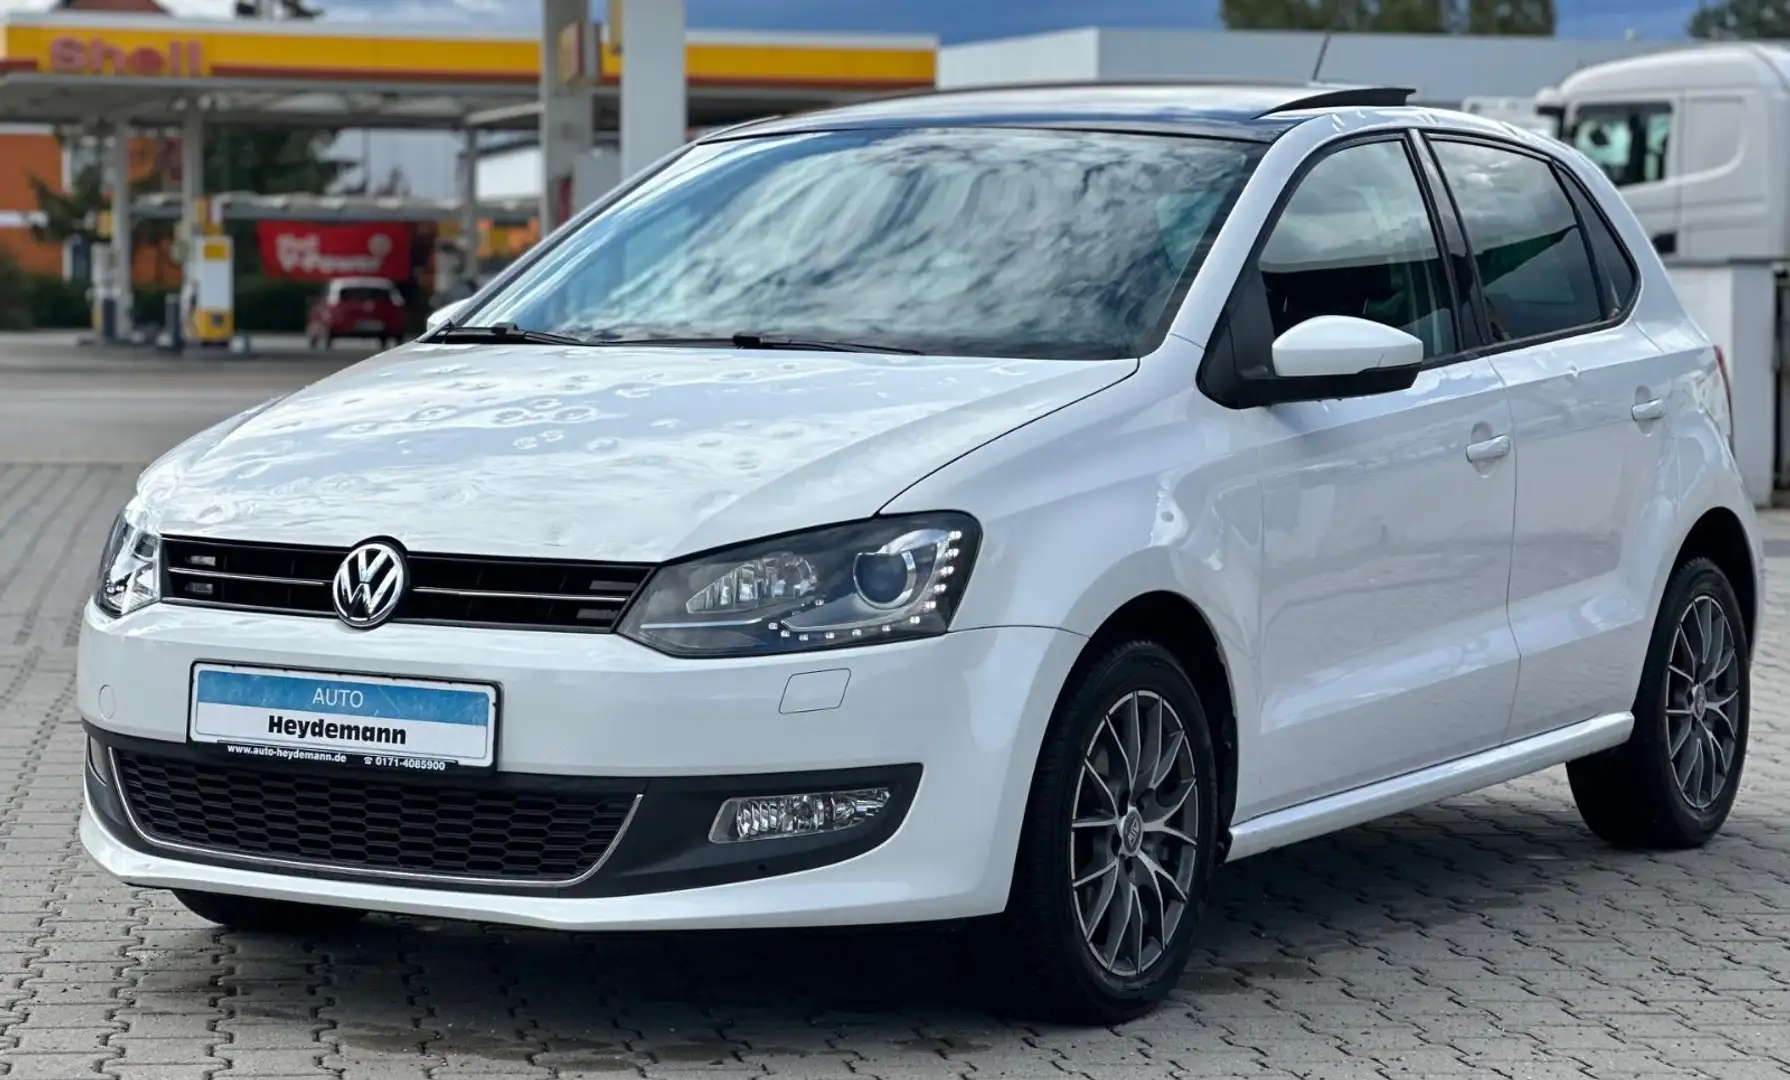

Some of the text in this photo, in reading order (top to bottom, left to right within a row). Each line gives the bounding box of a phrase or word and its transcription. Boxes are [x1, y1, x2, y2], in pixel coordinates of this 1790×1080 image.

[312, 687, 364, 708] AUTO
[268, 714, 407, 745] Heydemann
[227, 744, 446, 771] www.auto-heydemann.de 0171-4085900
